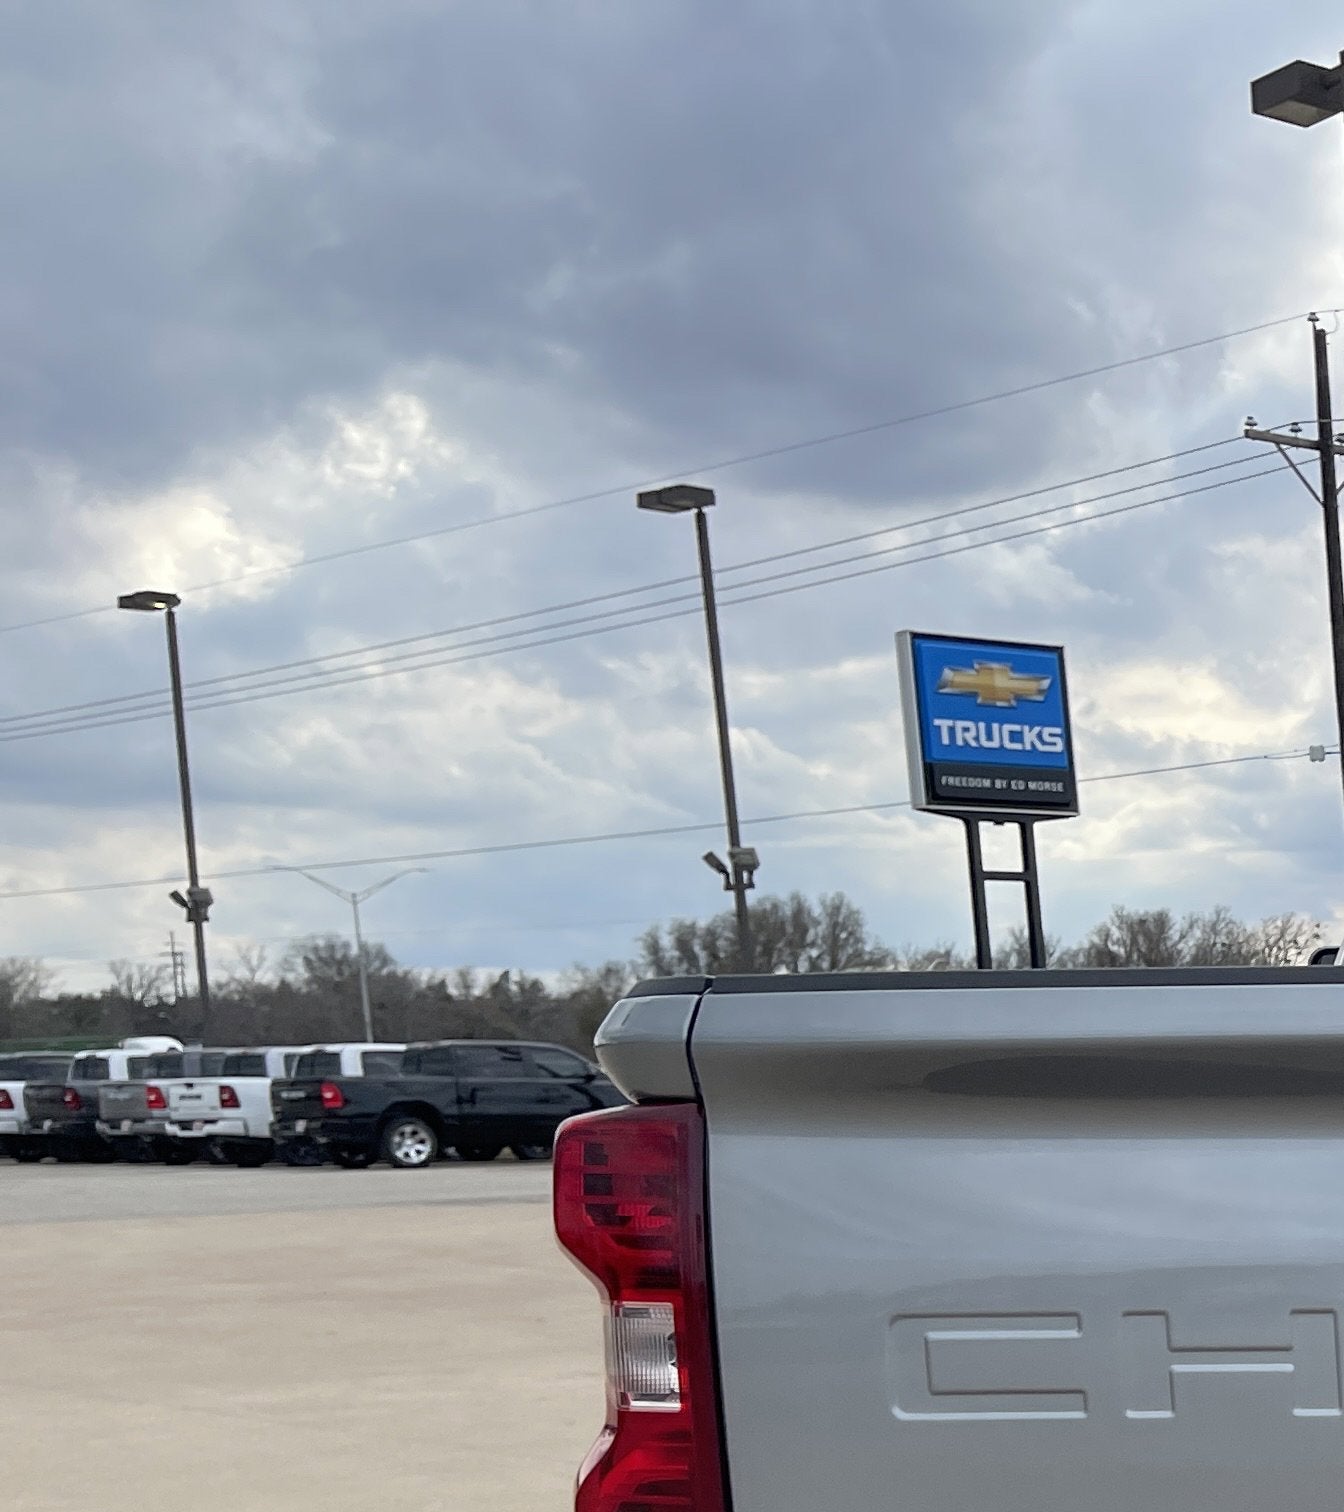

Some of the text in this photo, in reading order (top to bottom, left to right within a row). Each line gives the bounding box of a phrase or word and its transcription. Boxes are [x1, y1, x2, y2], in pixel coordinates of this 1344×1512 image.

[933, 718, 1063, 752] TRUCKS
[941, 775, 1064, 792] FREEDOM BY ED MORSE
